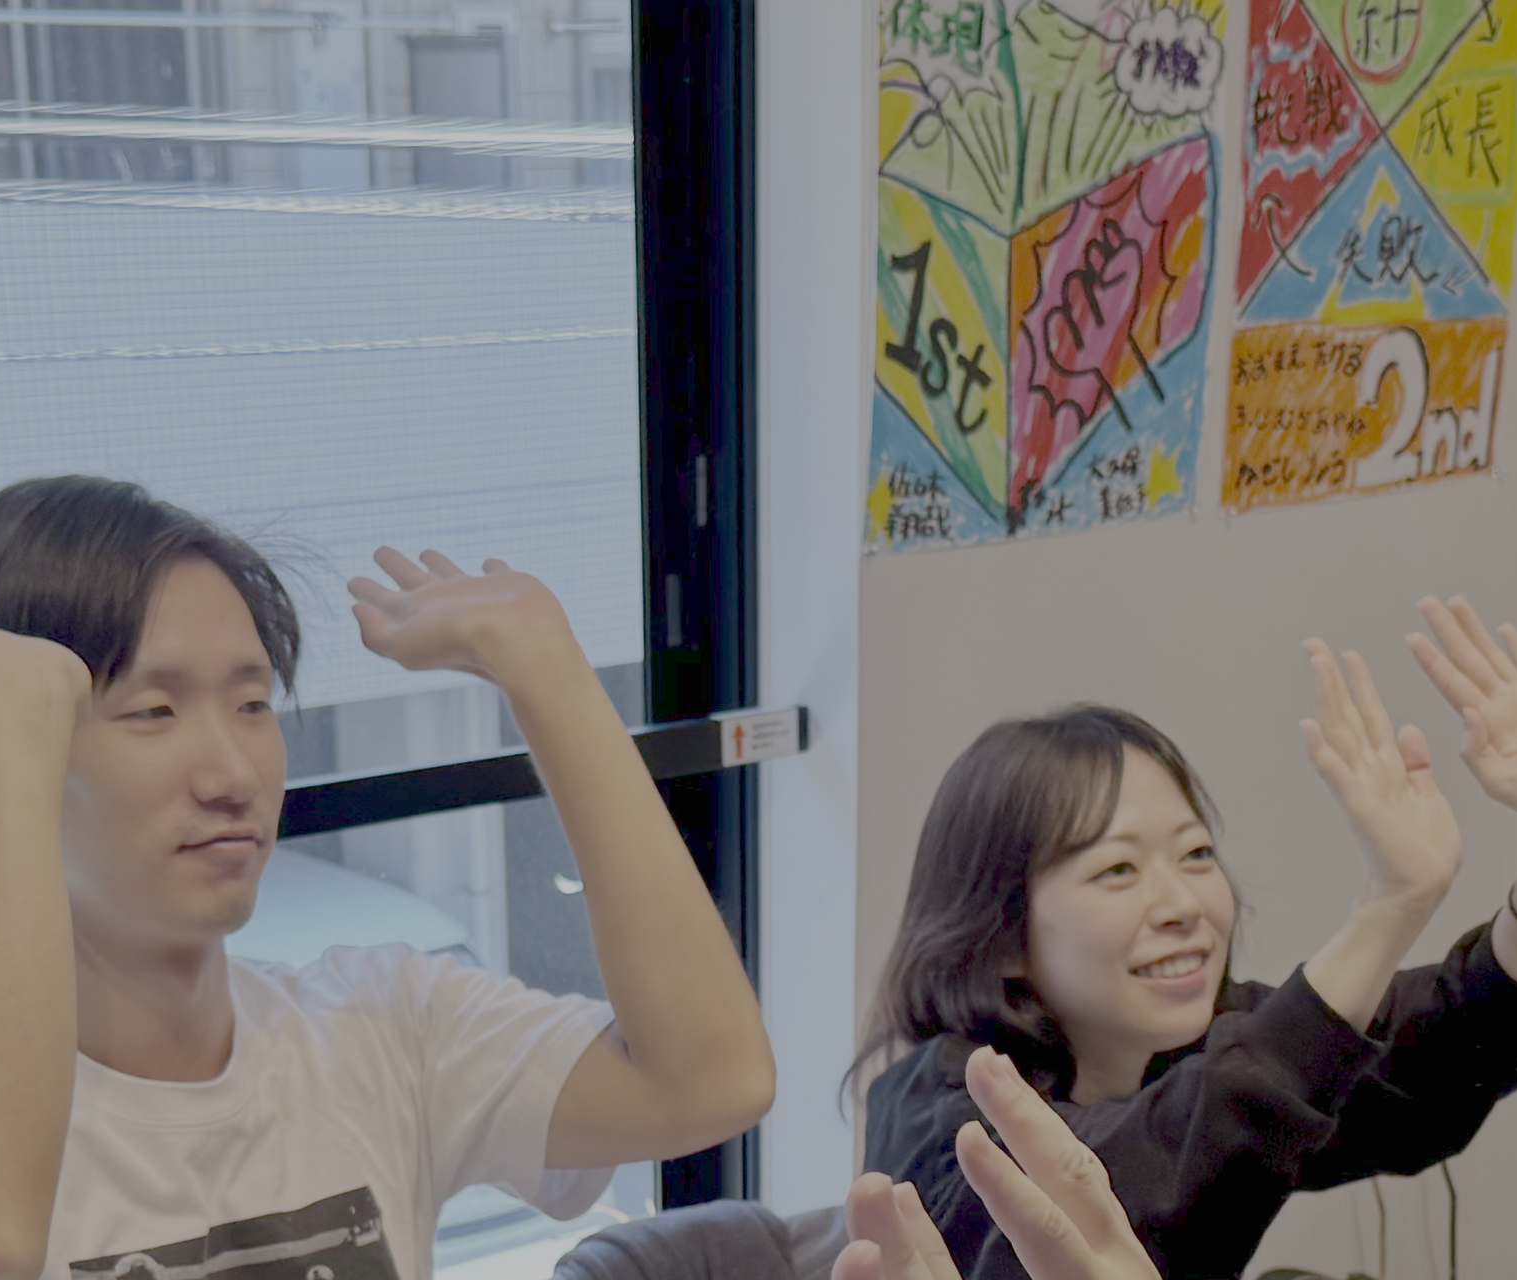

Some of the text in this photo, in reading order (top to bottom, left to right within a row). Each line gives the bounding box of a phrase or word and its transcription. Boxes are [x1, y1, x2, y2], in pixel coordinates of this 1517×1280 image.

[1413, 80, 1503, 189] 成長
[1336, 213, 1443, 285] 失敗
[885, 240, 993, 438] 1st
[1354, 325, 1505, 489] 2nd
